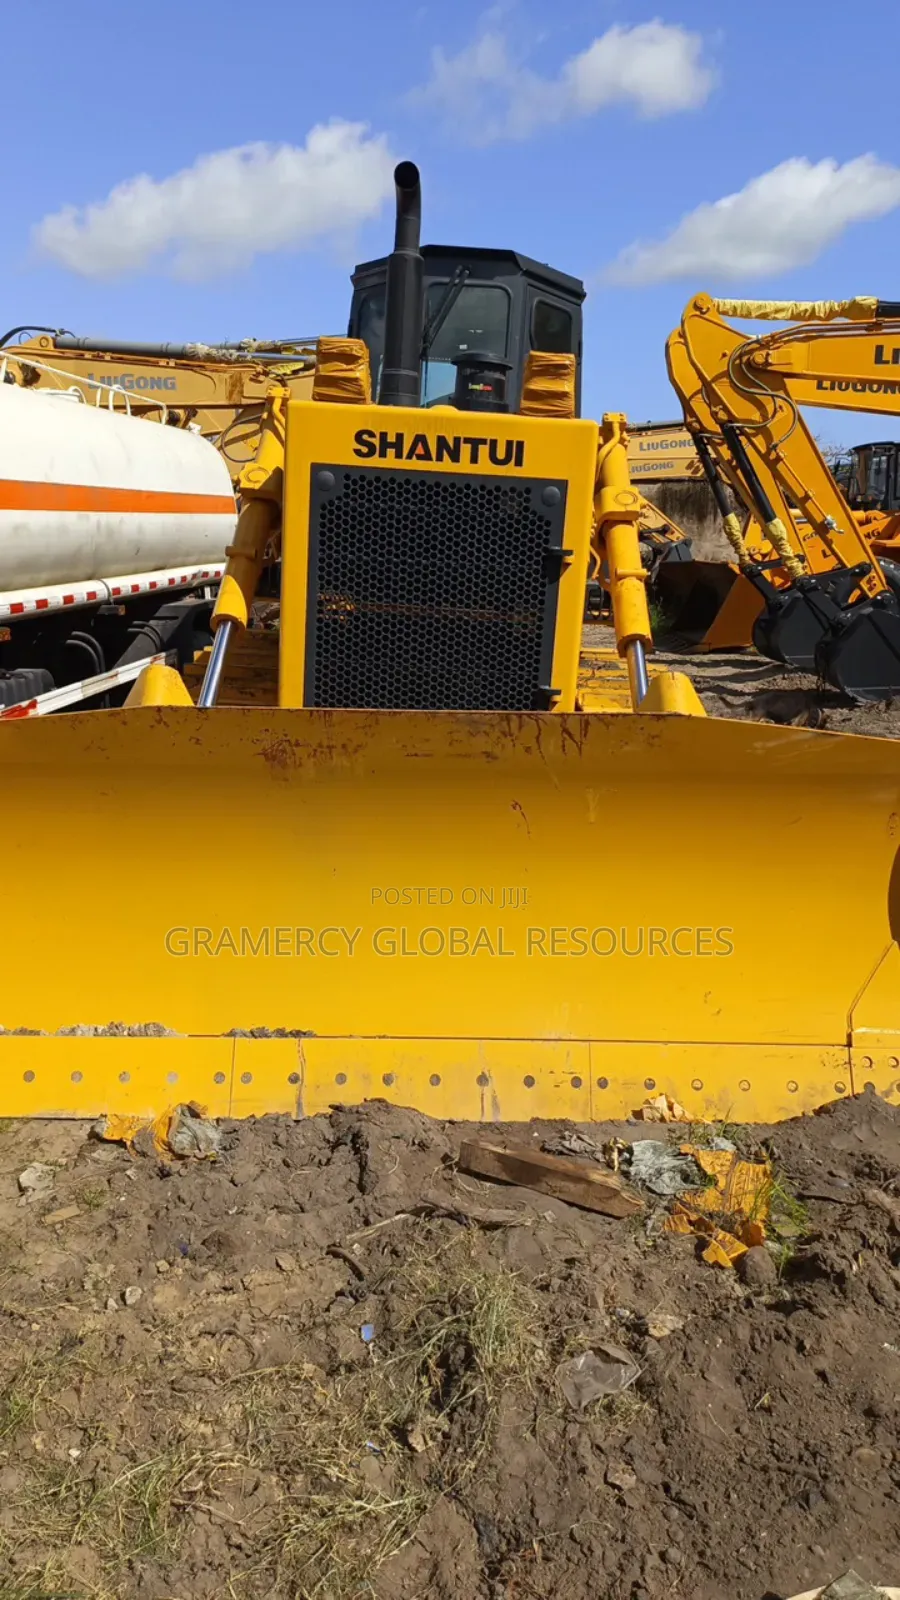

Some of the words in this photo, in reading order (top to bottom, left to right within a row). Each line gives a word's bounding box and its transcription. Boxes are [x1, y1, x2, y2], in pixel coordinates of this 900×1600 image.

[816, 379, 900, 394] LIUGON
[352, 429, 525, 467] SHANTUI
[628, 461, 675, 473] IUGONG
